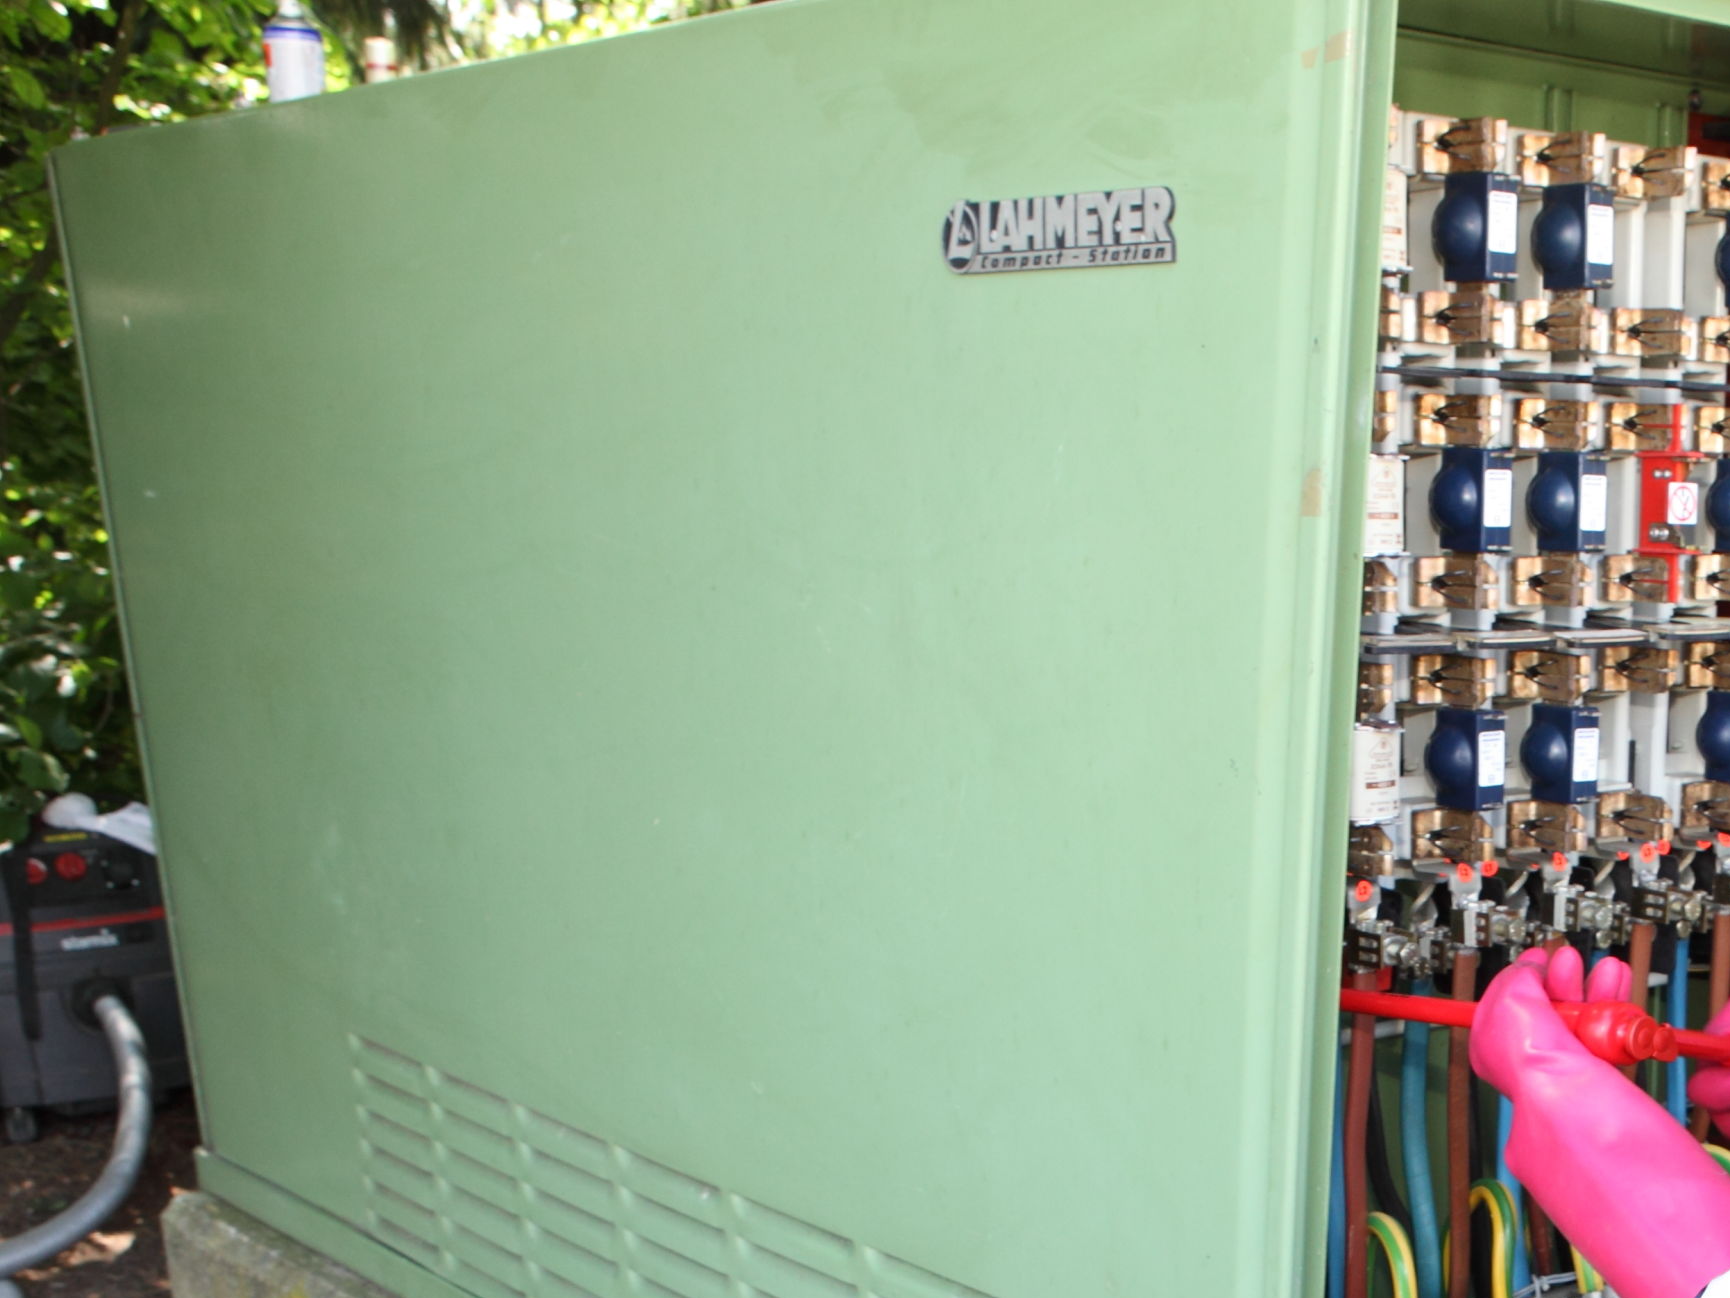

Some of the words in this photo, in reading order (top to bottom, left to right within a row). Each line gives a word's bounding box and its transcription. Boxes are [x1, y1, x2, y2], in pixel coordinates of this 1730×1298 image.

[979, 187, 1172, 252] LAHMEYER
[981, 252, 1063, 270] Compact
[1088, 245, 1166, 264] Station
